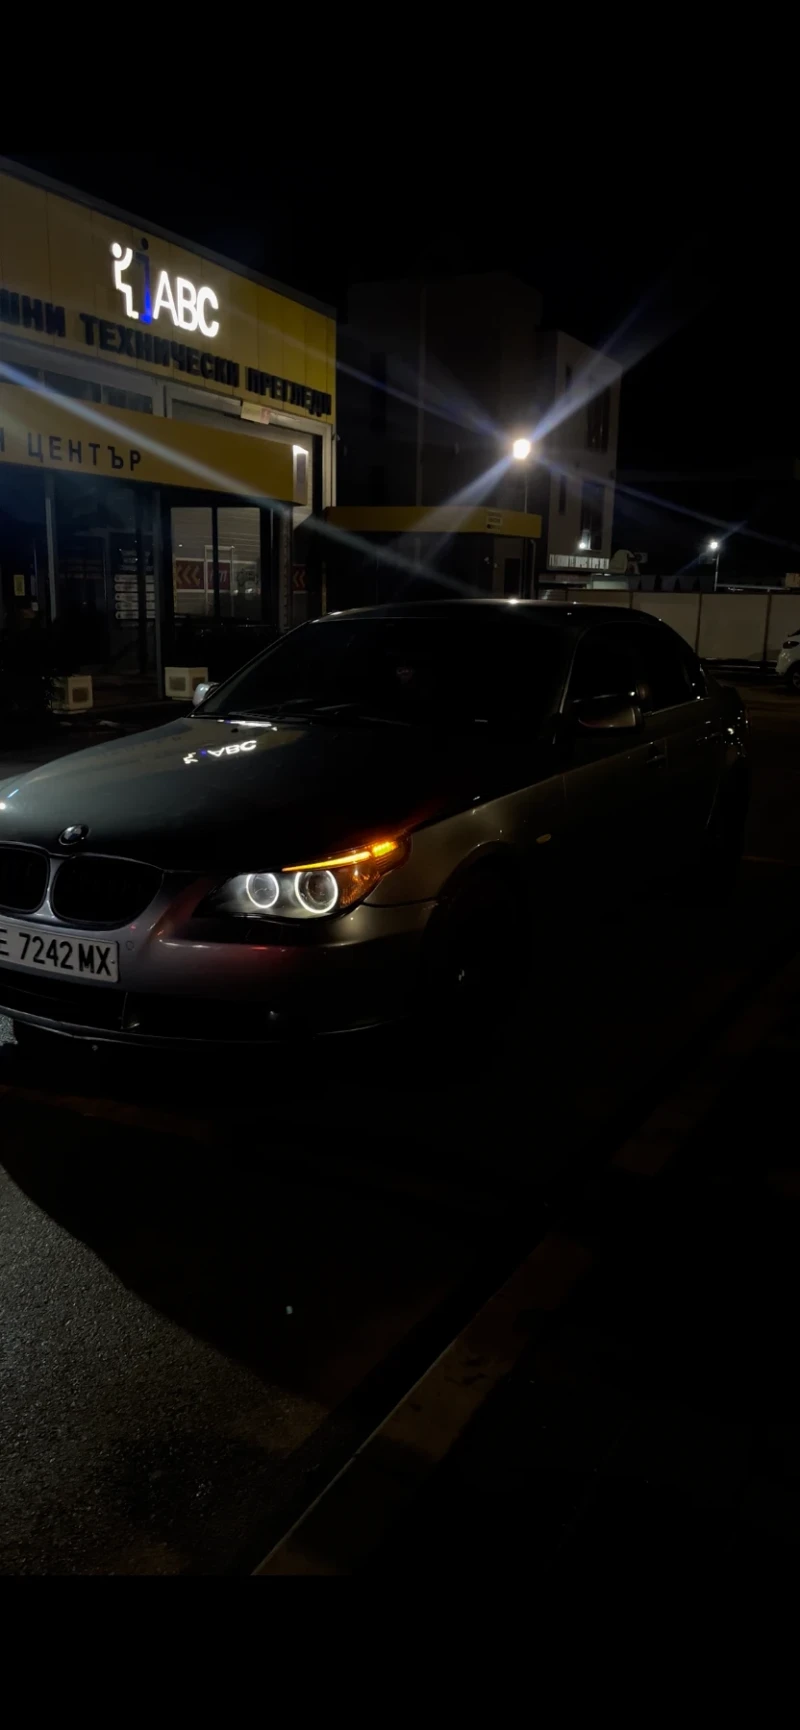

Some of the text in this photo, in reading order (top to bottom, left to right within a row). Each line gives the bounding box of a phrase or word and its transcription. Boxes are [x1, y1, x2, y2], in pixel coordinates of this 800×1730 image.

[79, 312, 240, 388] ТЕХНИЧЕСКИ
[245, 366, 332, 418] ПРЕГЛЕДИ
[27, 431, 142, 472] ЦЕНТЪР
